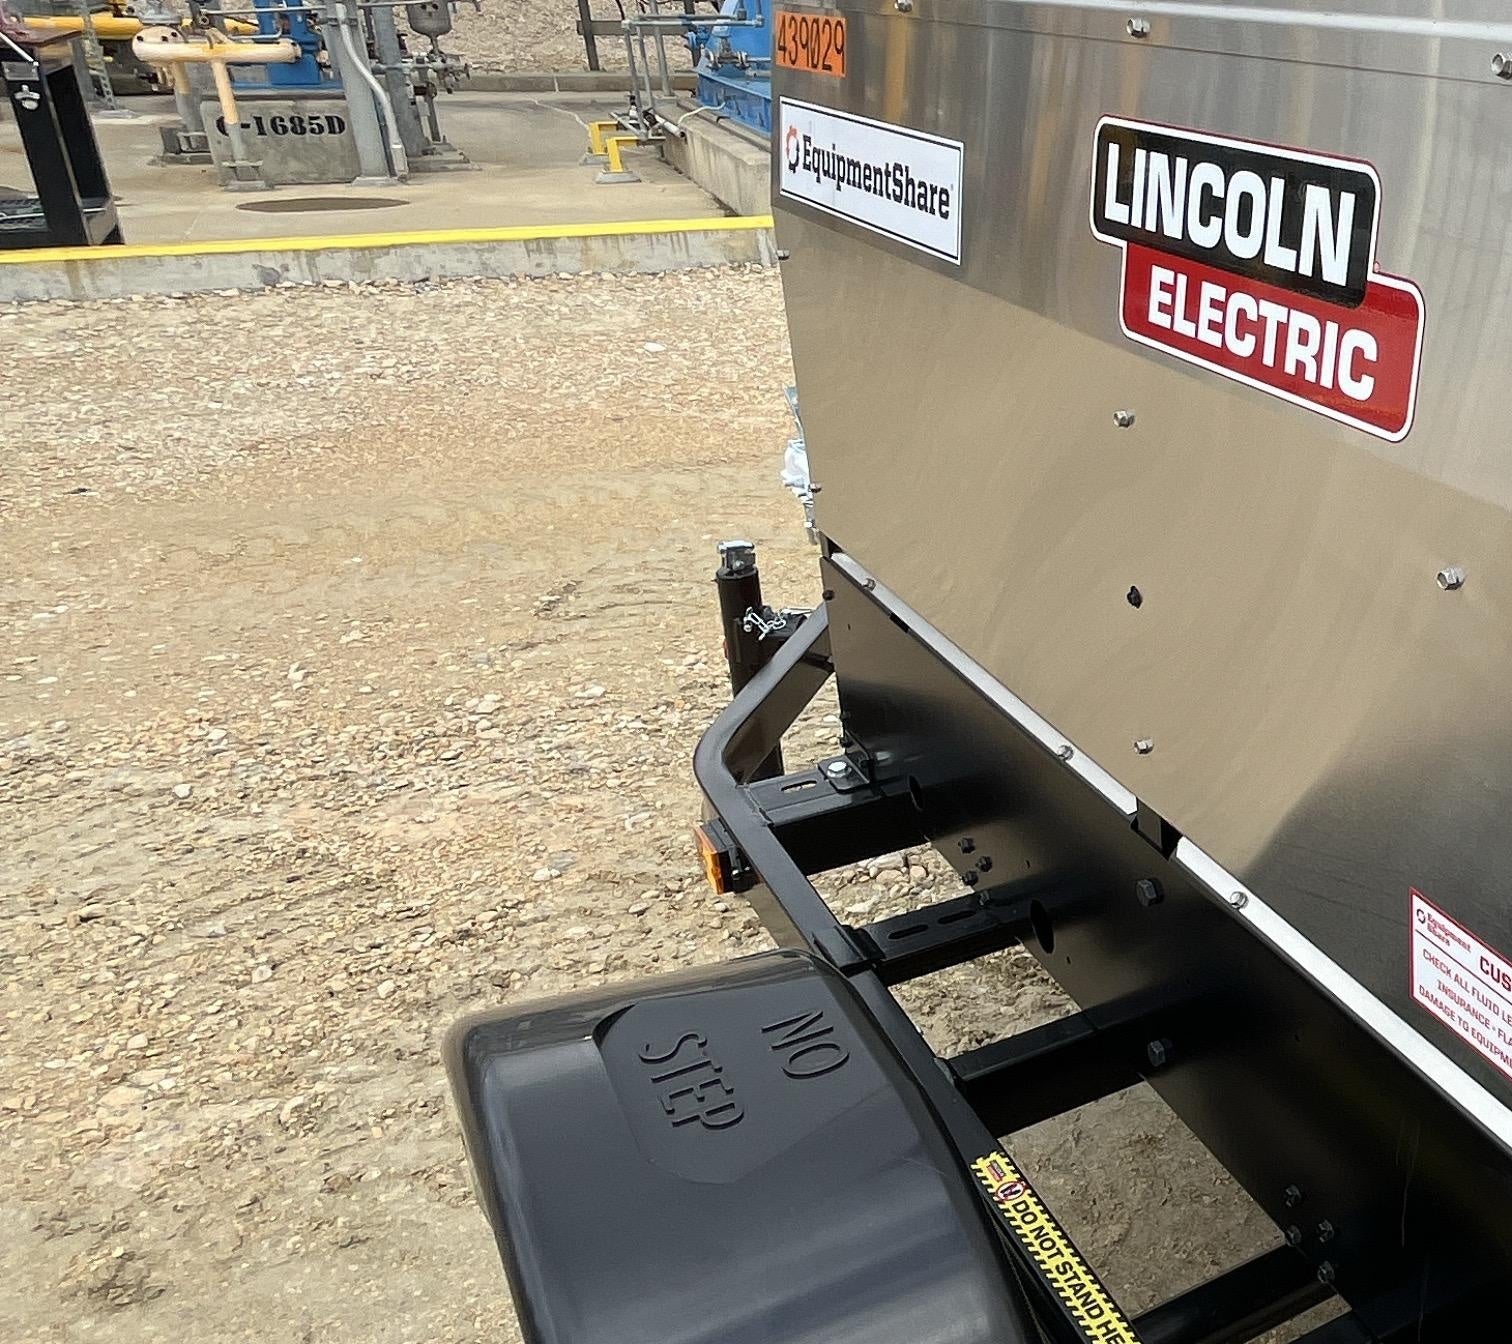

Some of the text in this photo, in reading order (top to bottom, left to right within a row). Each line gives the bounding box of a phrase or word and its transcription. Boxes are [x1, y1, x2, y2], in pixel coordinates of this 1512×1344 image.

[777, 15, 846, 73] 439029
[802, 135, 951, 220] EquipmentShare
[1103, 142, 1357, 288] LINCOLN
[1147, 266, 1380, 404] ELECTRIC
[1427, 912, 1471, 954] Equipment
[1419, 983, 1457, 1023] DAMAGE
[1458, 1014, 1471, 1033] TO
[1423, 947, 1452, 978] CHECK
[1454, 972, 1470, 993] ALL
[1471, 986, 1501, 1016] FLUID
[1437, 979, 1491, 1031] INSURANCE
[760, 1008, 852, 1081] NO
[637, 1030, 747, 1133] STEP
[1012, 1199, 1039, 1225] DO
[1028, 1224, 1065, 1262] NOT
[1055, 1259, 1105, 1321] STAND
